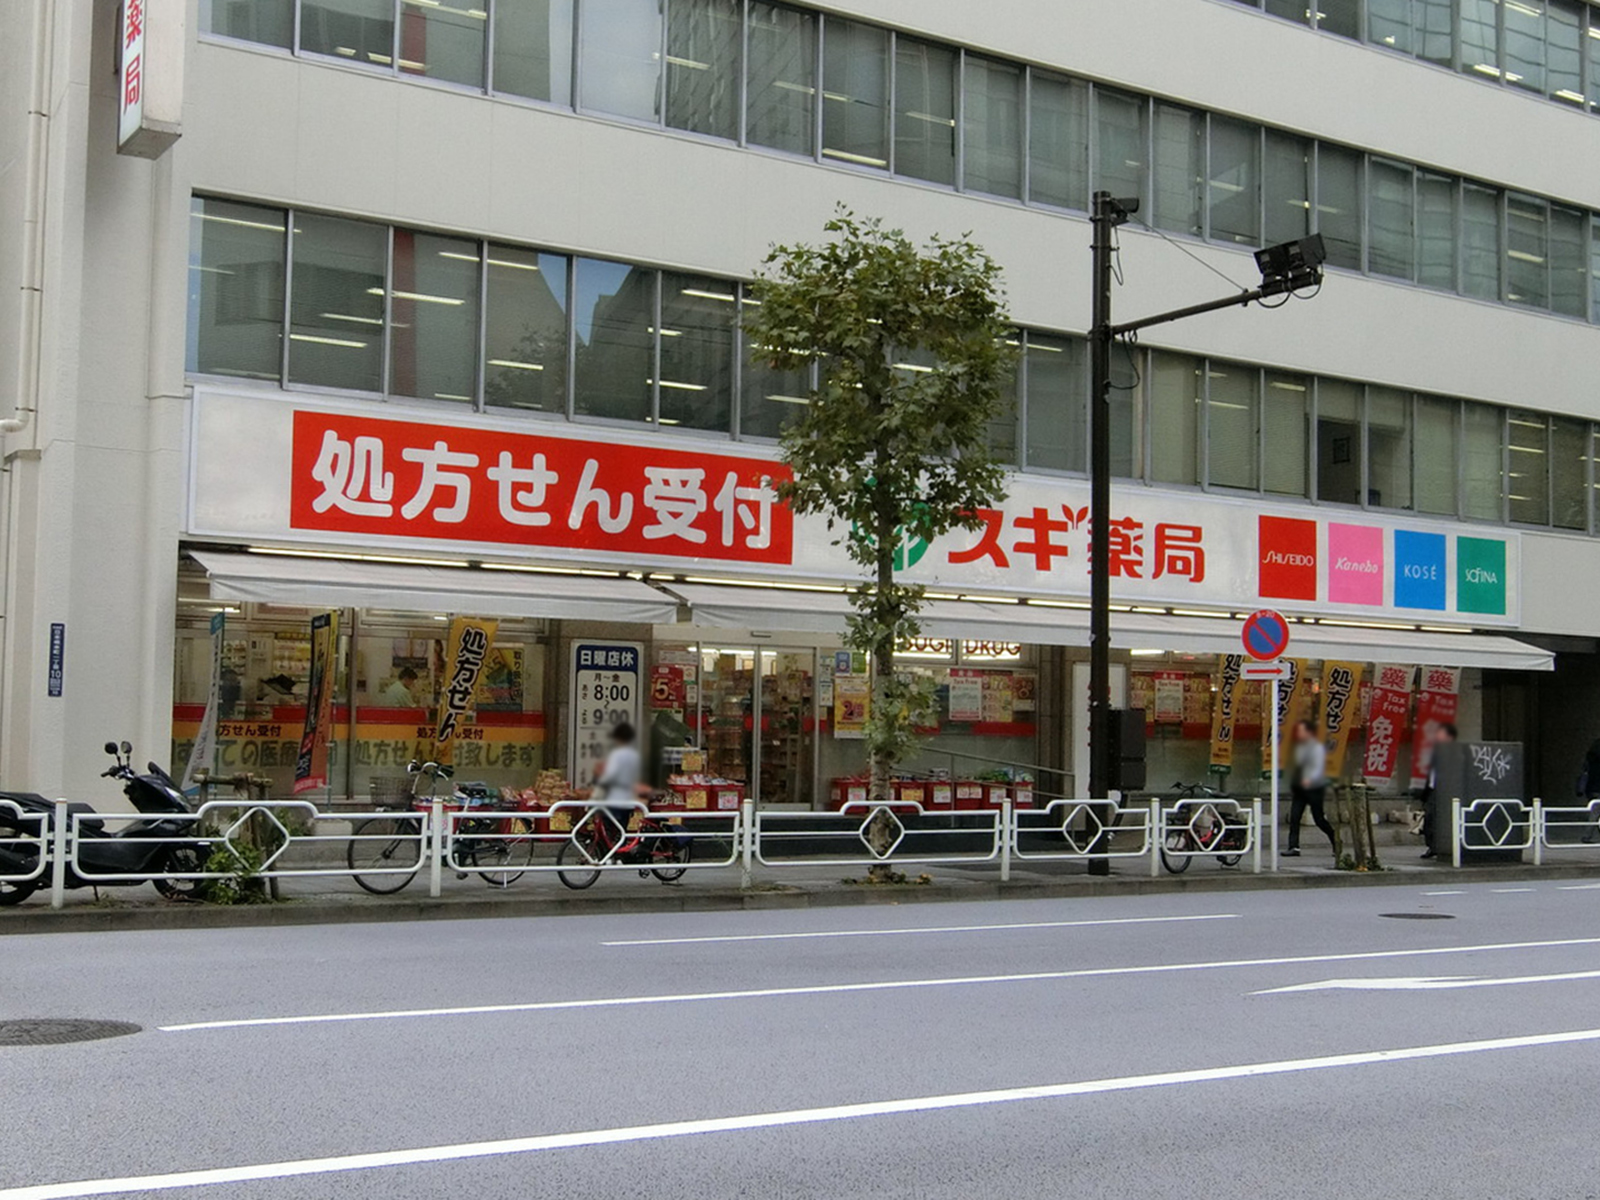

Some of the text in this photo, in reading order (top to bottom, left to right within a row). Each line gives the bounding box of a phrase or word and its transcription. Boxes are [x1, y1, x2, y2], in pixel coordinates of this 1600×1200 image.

[311, 429, 779, 550] 処方せん受付
[947, 505, 1205, 584] スギ薬局
[1262, 550, 1314, 567] SHISEIDO
[1335, 557, 1379, 575] Kanebo
[1404, 564, 1437, 581] KOSÉ
[965, 639, 1022, 655] DRUG
[580, 650, 635, 667] 日曜店休
[439, 627, 487, 741] 処方せん
[594, 684, 630, 701] 8:00
[1218, 653, 1243, 742] 処方せん
[1386, 693, 1406, 704] Tax
[1434, 695, 1454, 706] Tax
[1382, 701, 1406, 714] Free
[593, 708, 629, 725] 9:00
[219, 724, 282, 737] 方せん受付
[416, 727, 484, 740] 処方受付
[1367, 715, 1393, 772] 免税
